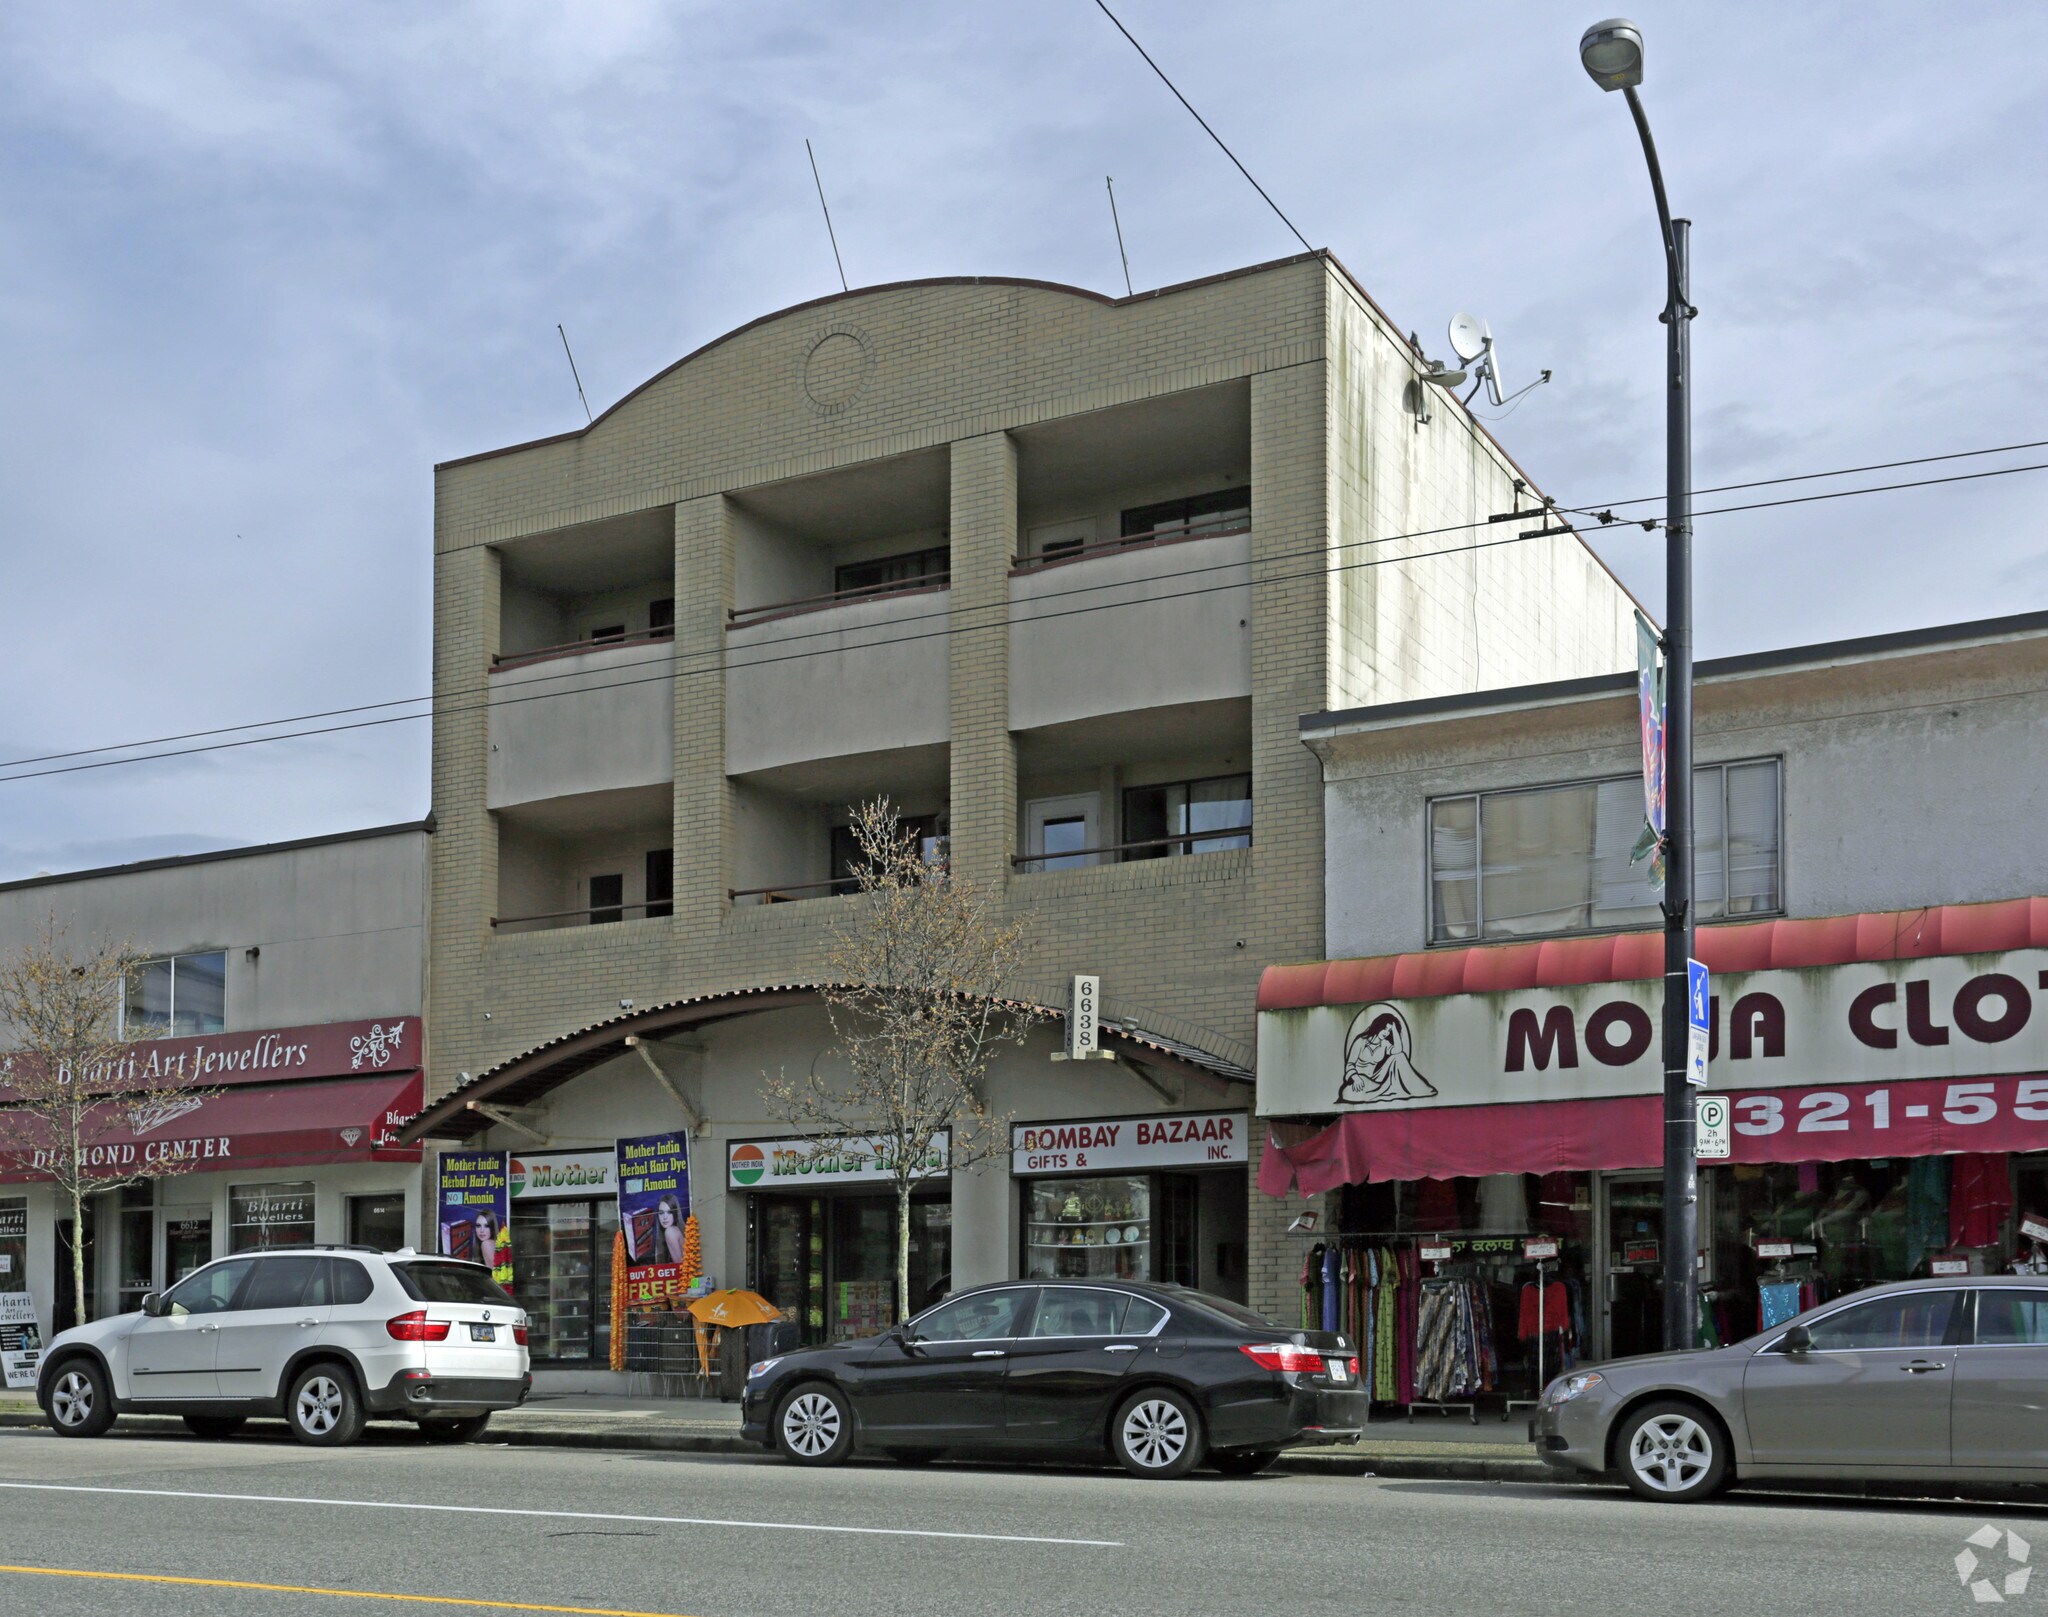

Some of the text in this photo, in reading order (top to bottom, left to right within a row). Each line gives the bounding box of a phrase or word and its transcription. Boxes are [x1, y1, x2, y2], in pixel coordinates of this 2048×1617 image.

[1079, 981, 1093, 1046] 6638
[1504, 969, 2048, 1073] MOA CLO
[142, 1048, 188, 1079] Art
[191, 1034, 308, 1082] Jewellers
[1024, 1117, 1233, 1150] BOMBAY BAZAAR
[1707, 1129, 1718, 1137] 2h
[144, 1136, 231, 1161] CENTER
[625, 1140, 680, 1160] Mother India
[1207, 1145, 1232, 1160] INC.
[446, 1156, 499, 1172] Mother India
[620, 1161, 648, 1177] Herbal
[649, 1158, 669, 1174] Hair
[670, 1156, 687, 1174] Dye
[731, 1160, 764, 1169] MOTHER INDIA
[772, 1150, 864, 1177] Mother
[1027, 1152, 1088, 1169] GIFTS &
[441, 1173, 505, 1189] Herbal Hair Dye
[532, 1163, 608, 1188] Mother
[643, 1175, 677, 1192] Amonia
[463, 1190, 495, 1204] Amonia
[247, 1199, 303, 1213] Bharti
[180, 1220, 199, 1230] 6612
[246, 1213, 304, 1223] Jewellers
[629, 1267, 677, 1281] BUY 3 GET
[628, 1279, 680, 1300] FREE
[0, 1295, 31, 1307] harti
